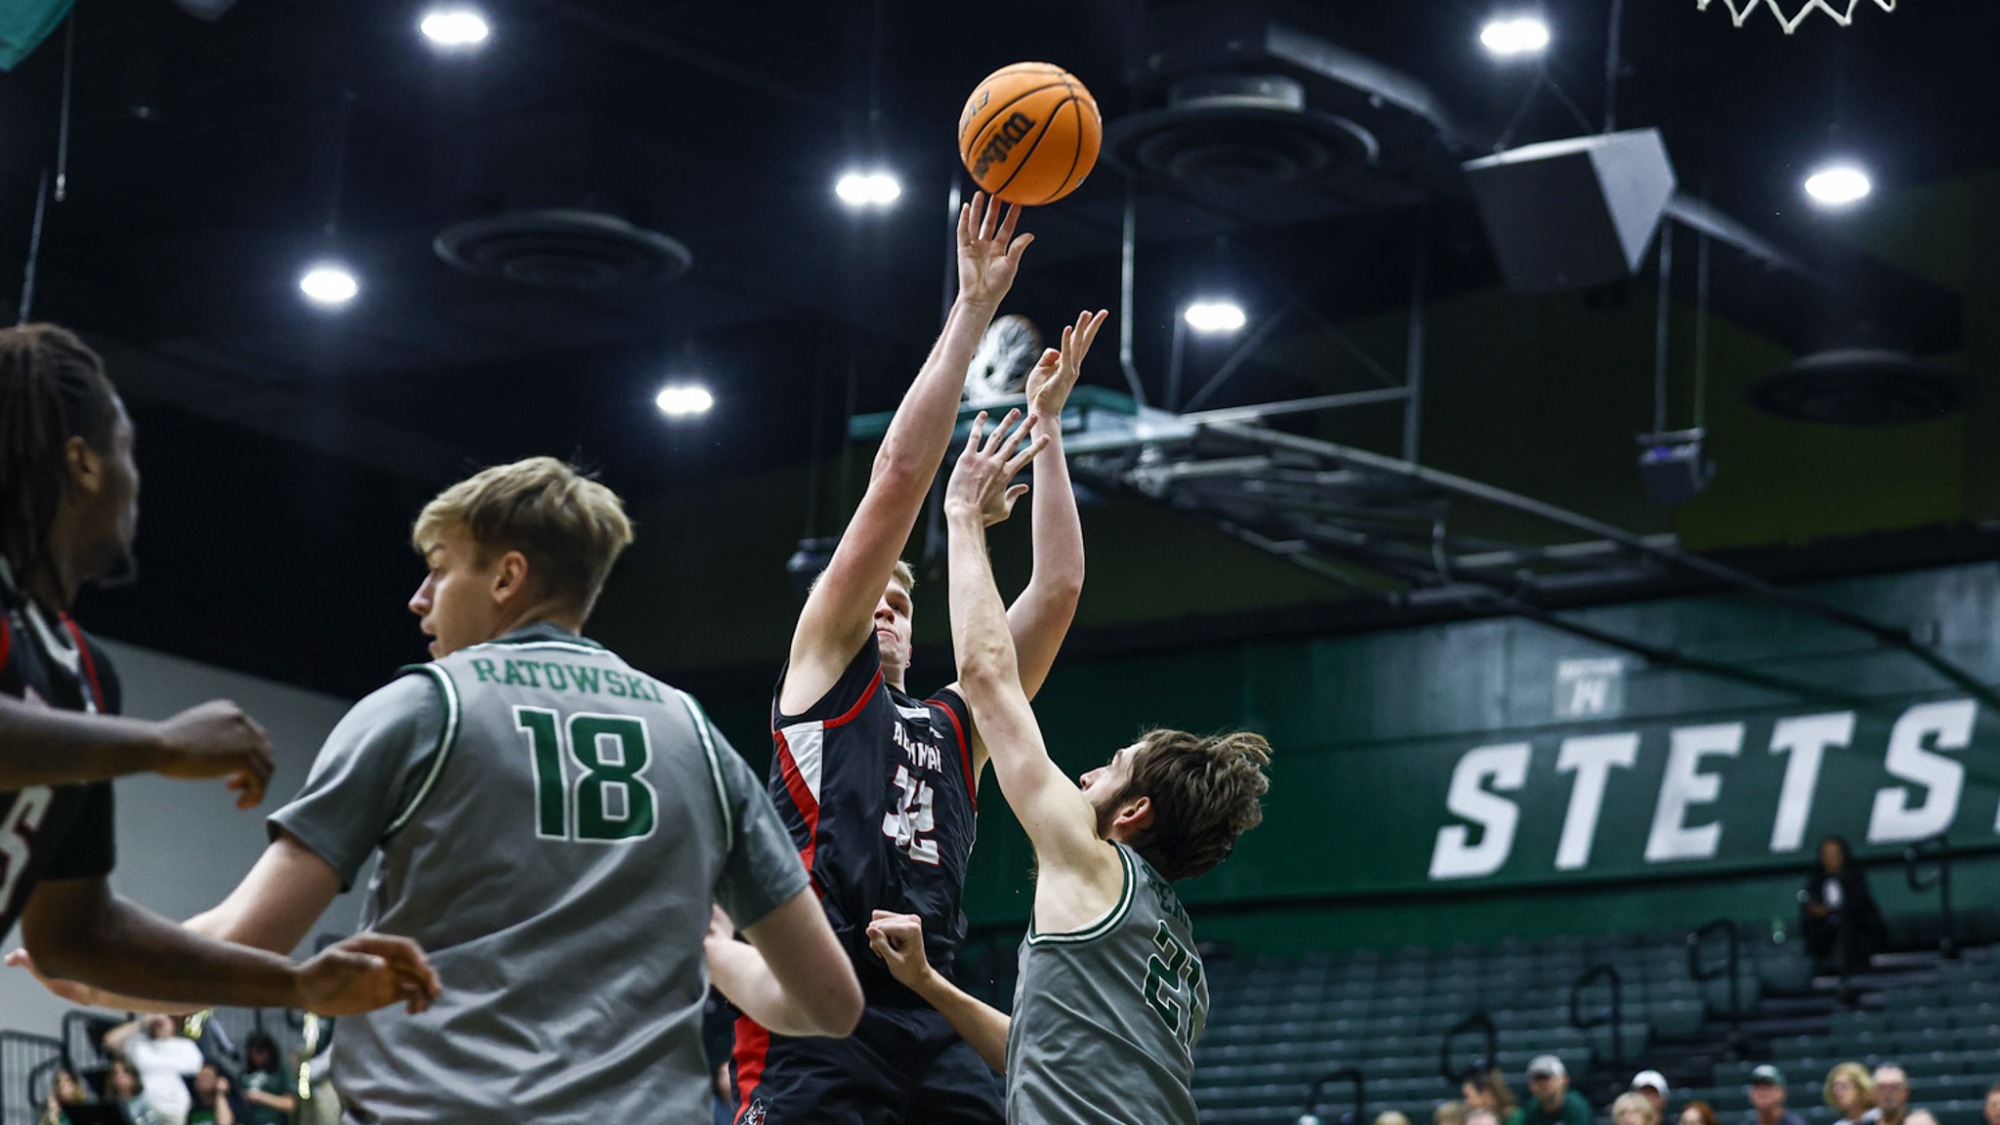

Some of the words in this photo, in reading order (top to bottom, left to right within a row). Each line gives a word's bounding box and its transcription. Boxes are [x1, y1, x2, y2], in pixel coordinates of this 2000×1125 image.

[472, 656, 664, 702] RATOWSKI
[512, 704, 658, 842] 18
[1429, 700, 2000, 880] STETS
[1143, 919, 1202, 1056] 21
